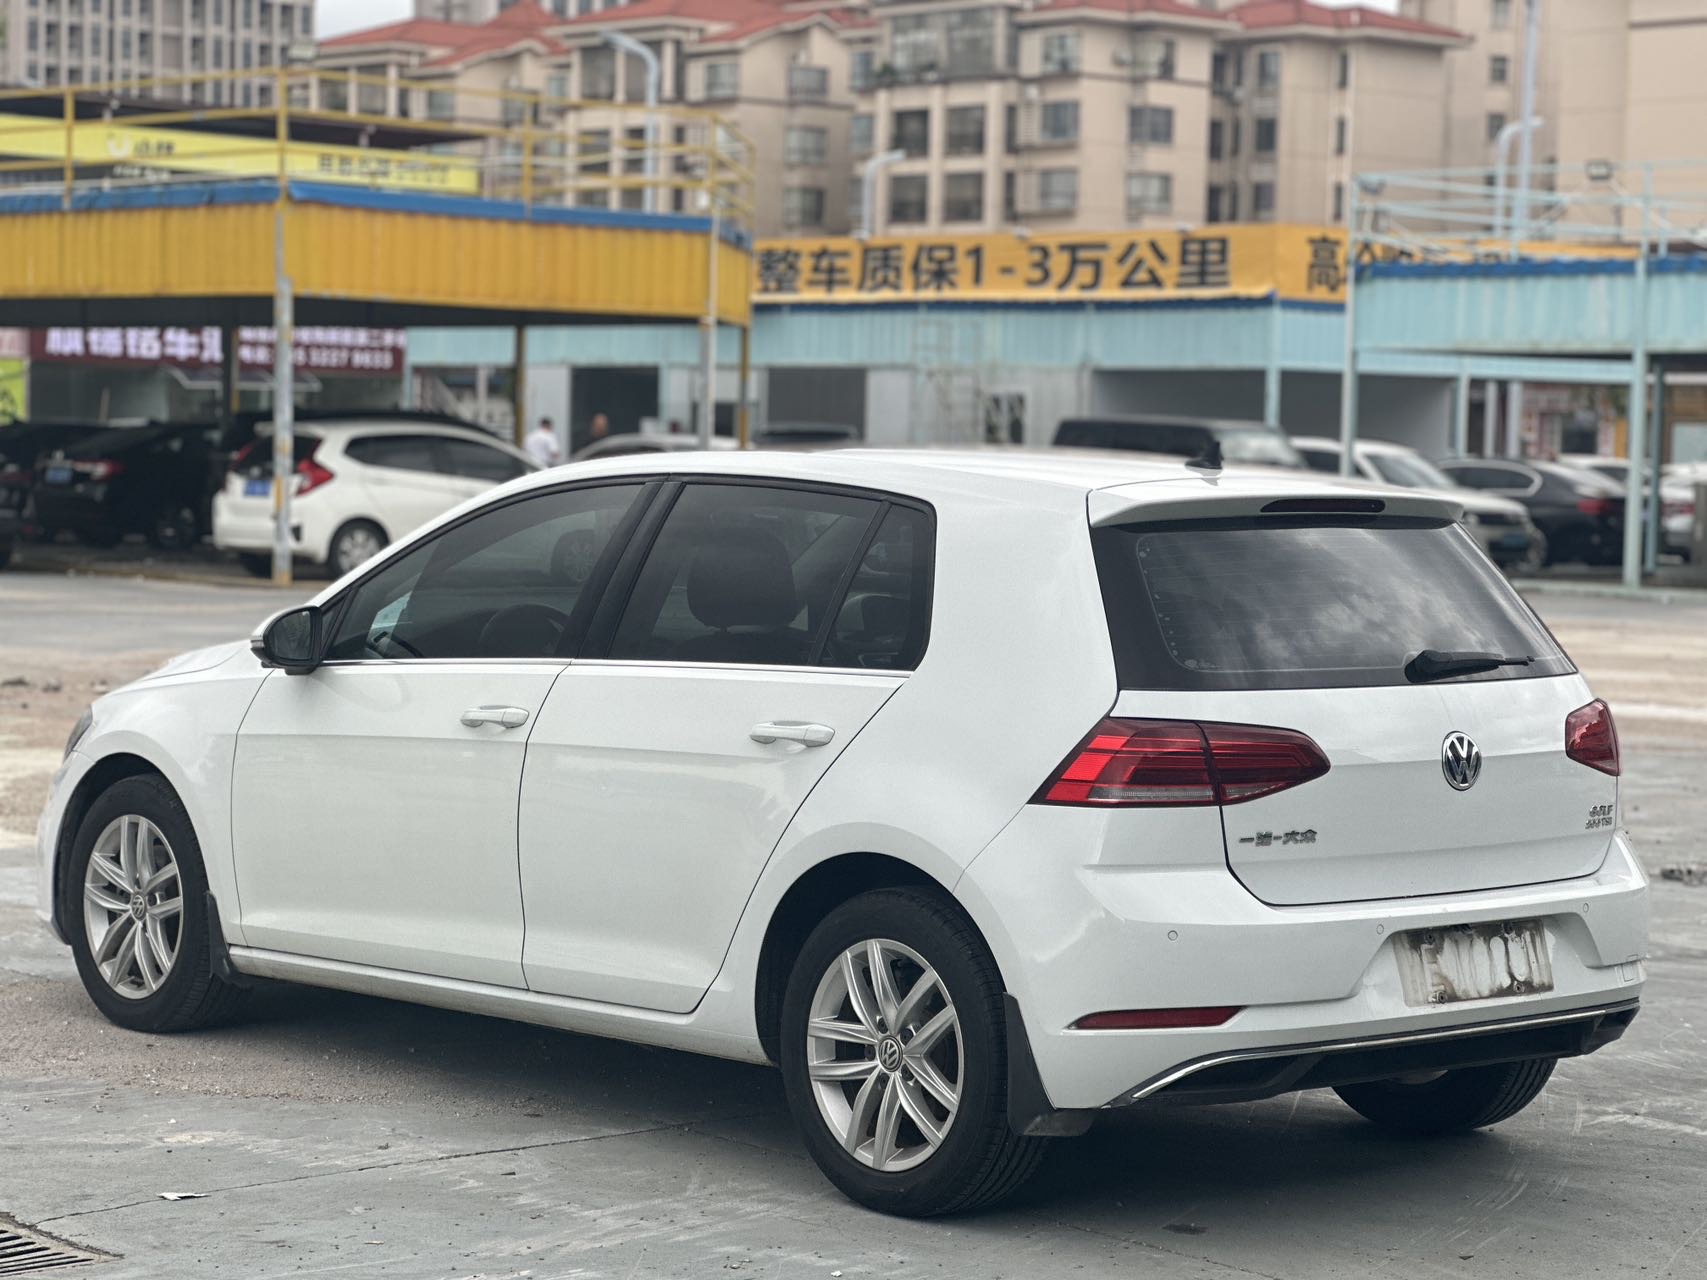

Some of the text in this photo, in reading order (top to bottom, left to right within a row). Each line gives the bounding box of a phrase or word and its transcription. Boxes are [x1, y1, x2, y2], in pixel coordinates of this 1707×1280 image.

[757, 238, 1229, 294] 整车质保1-3万公里
